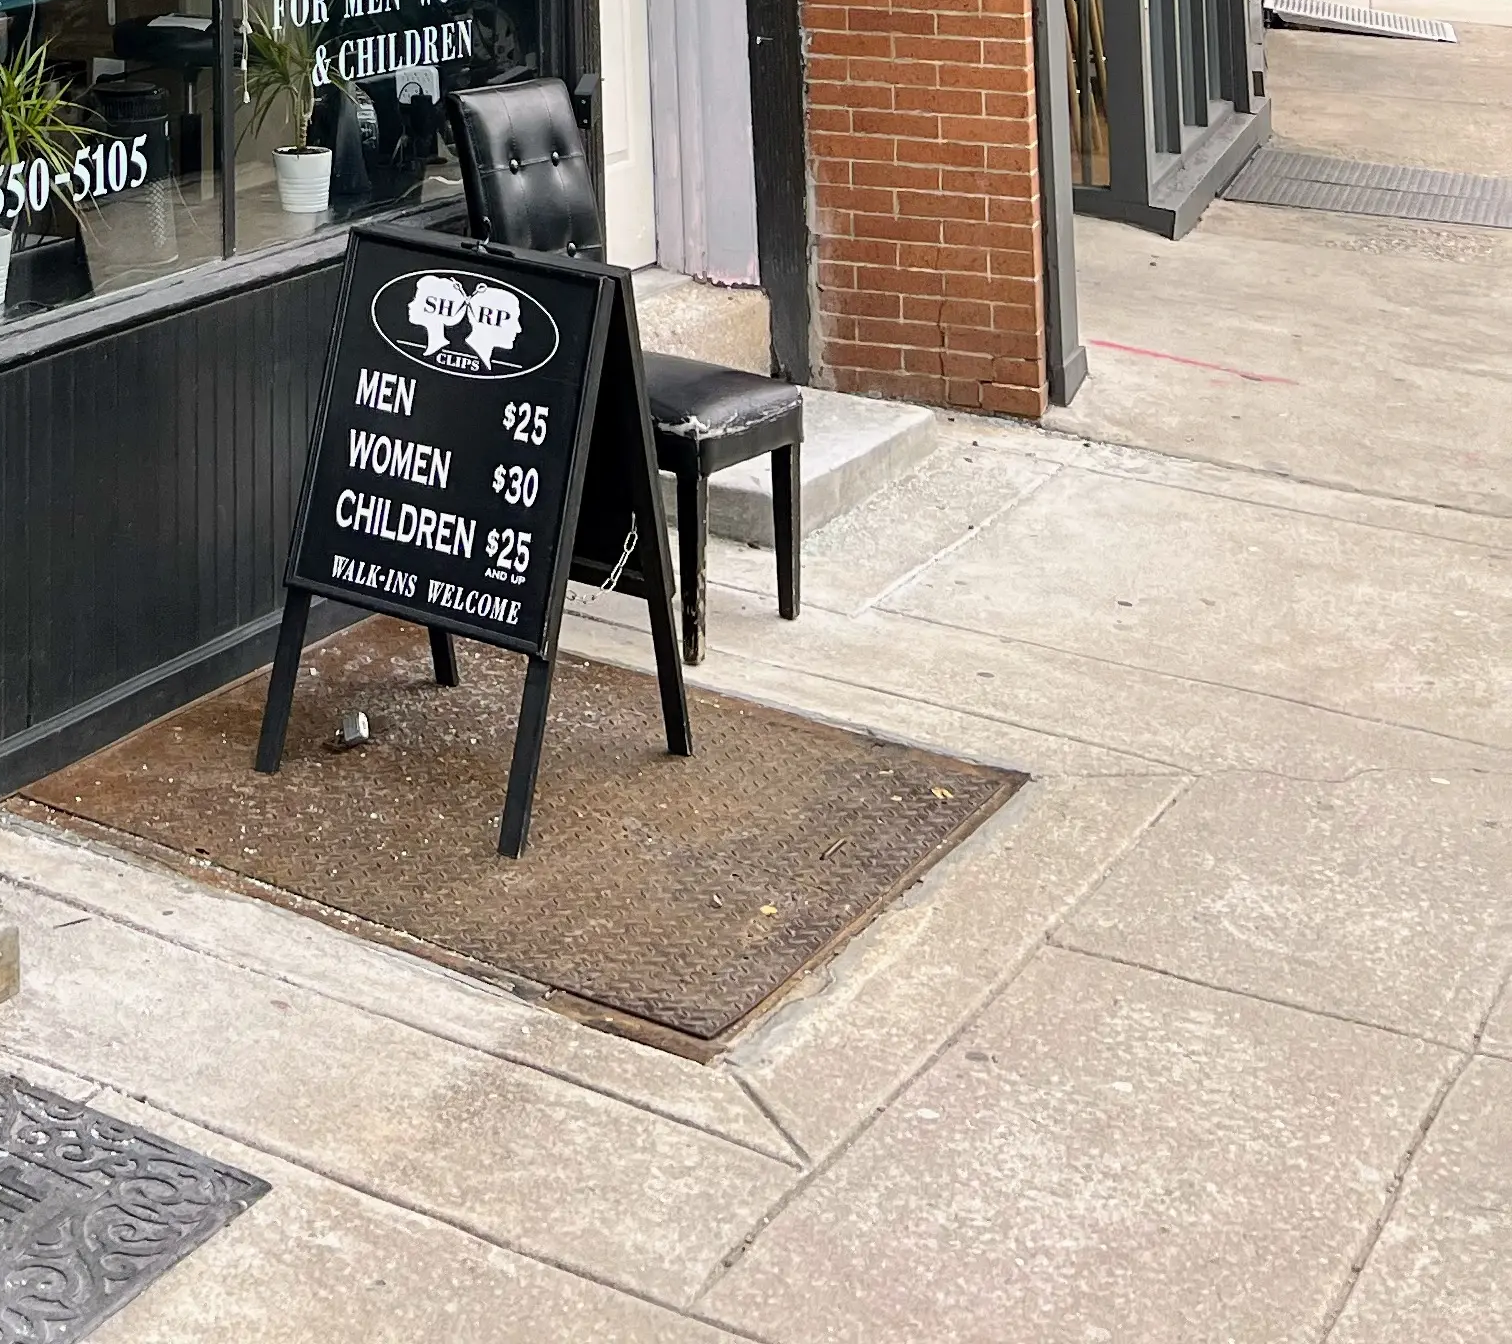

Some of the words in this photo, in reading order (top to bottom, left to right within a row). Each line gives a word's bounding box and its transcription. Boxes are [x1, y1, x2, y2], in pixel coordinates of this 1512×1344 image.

[338, 19, 473, 82] CHILDREN
[423, 295, 511, 328] SHARP
[436, 352, 480, 372] CLIPS
[354, 368, 417, 417] MEN
[502, 401, 550, 446] $25
[348, 428, 452, 490] WOMEN
[492, 463, 540, 508] $30
[335, 488, 477, 559] CHILDREN
[485, 527, 533, 573] $25
[427, 578, 523, 626] WELCOME
[484, 567, 508, 582] AND
[510, 574, 527, 586] UP
